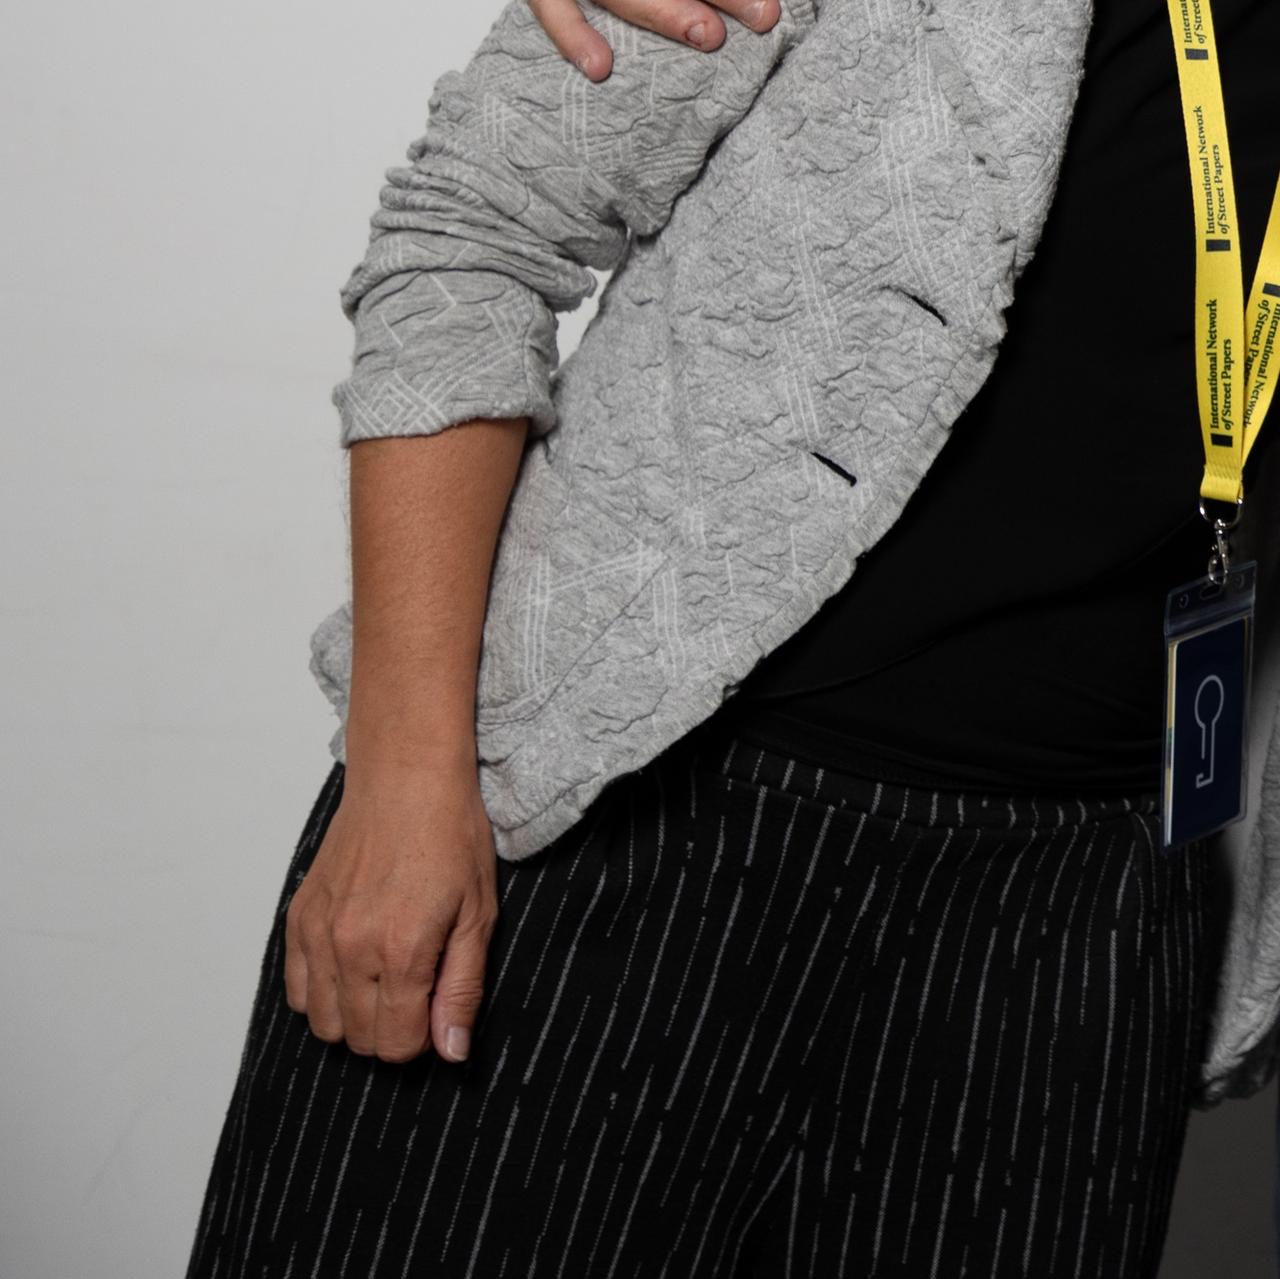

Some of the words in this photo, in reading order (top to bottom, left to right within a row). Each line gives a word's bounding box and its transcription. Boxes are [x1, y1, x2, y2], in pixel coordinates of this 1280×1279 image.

[1193, 31, 1207, 44] of
[1193, 105, 1208, 155] Network
[1212, 144, 1224, 184] Papers
[1199, 157, 1215, 235] International
[1216, 187, 1227, 221] Street
[1218, 220, 1230, 234] of
[1257, 299, 1271, 314] of
[1206, 299, 1218, 350] Network
[1250, 312, 1269, 347] Street
[1221, 338, 1234, 380] Papers
[1206, 352, 1219, 429] International
[1221, 382, 1232, 417] Street
[1221, 417, 1234, 431] of
